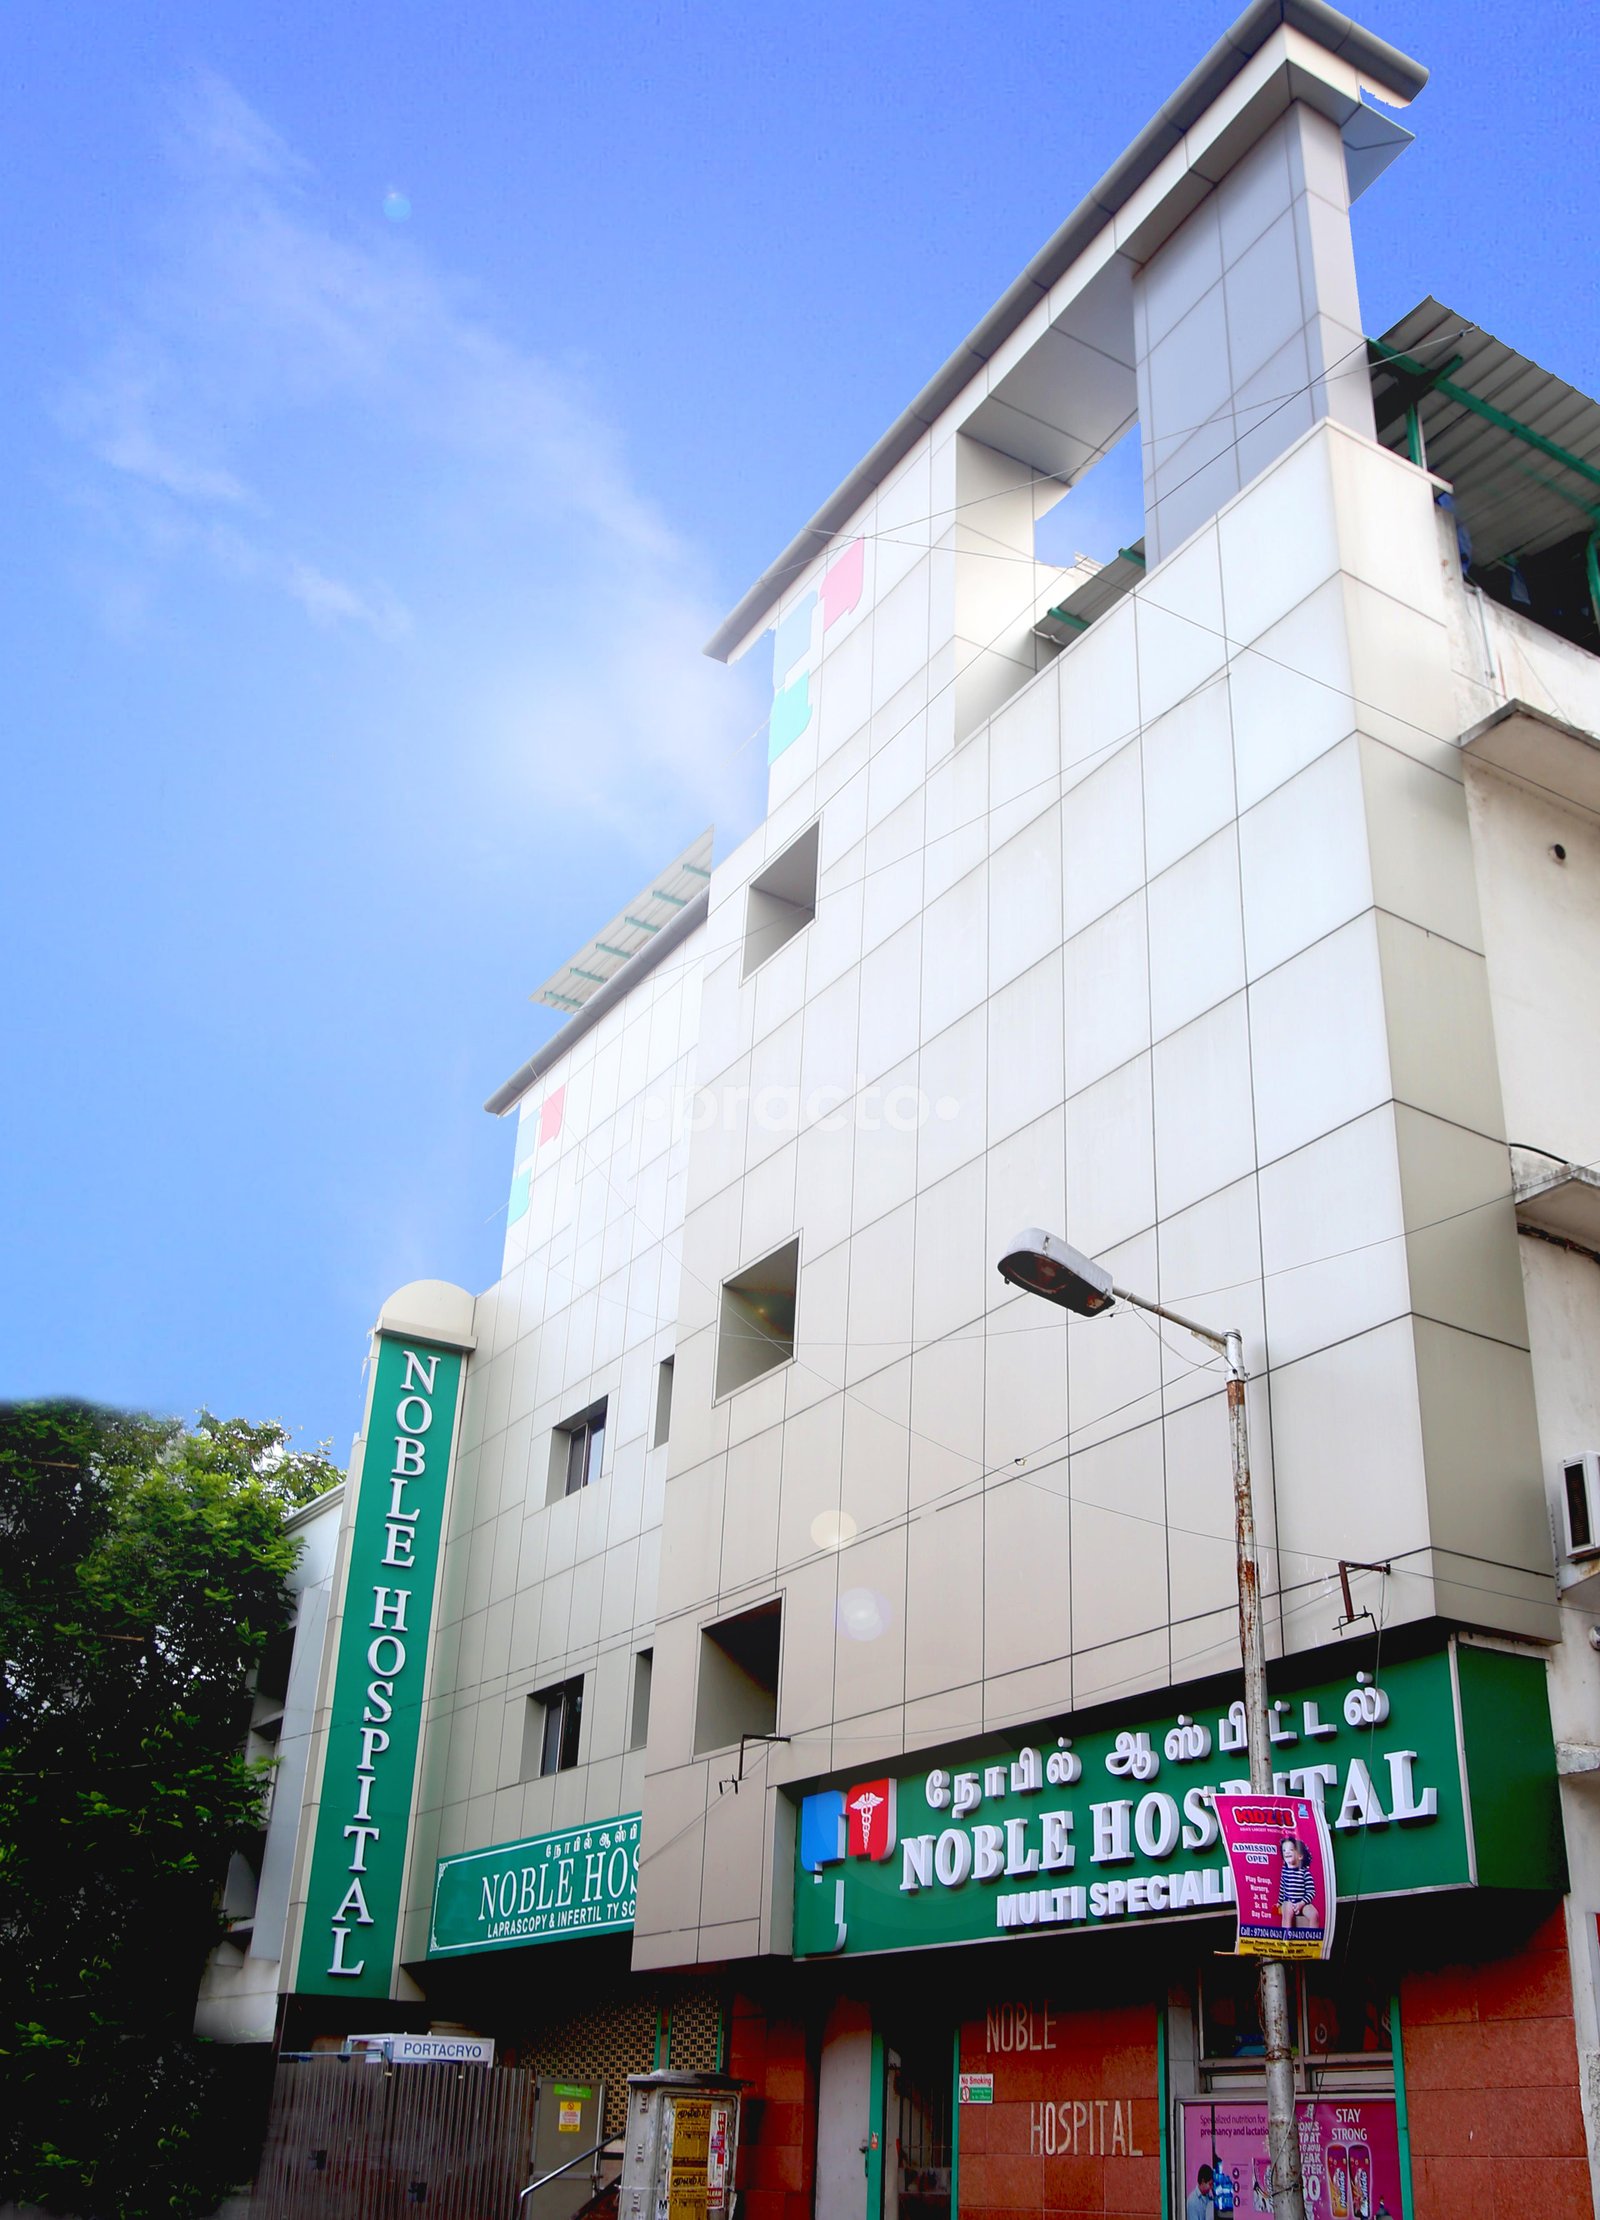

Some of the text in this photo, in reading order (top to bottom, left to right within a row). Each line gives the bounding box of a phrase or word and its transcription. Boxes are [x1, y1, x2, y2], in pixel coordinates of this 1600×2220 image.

[327, 1350, 441, 1977] NOBLE HOSPITAL
[925, 1736, 1082, 1819] நோபில்
[899, 1750, 1438, 1890] NOBLE HOSTAL
[1233, 1807, 1296, 1828] KIDZEE
[546, 1832, 592, 1860] நோபில்
[1233, 1843, 1277, 1853] ADMISSION
[1246, 1854, 1268, 1863] OPEN
[478, 1858, 574, 1921] NOBLE
[997, 1885, 1087, 1927] MULTI
[487, 1915, 547, 1938] LAPRASCOPY
[549, 1915, 555, 1928] &
[986, 2000, 1057, 2053] NOBLE
[404, 2041, 482, 2058] PORTACRYO
[969, 2075, 992, 2087] Smoking
[1200, 2114, 1266, 2126] Spealized nutrition for
[1335, 2108, 1361, 2123] STAY
[1030, 2100, 1144, 2156] HOSPITAL
[1200, 2127, 1232, 2138] prenancy
[1233, 2126, 1245, 2135] and
[1331, 2128, 1367, 2141] STRONG
